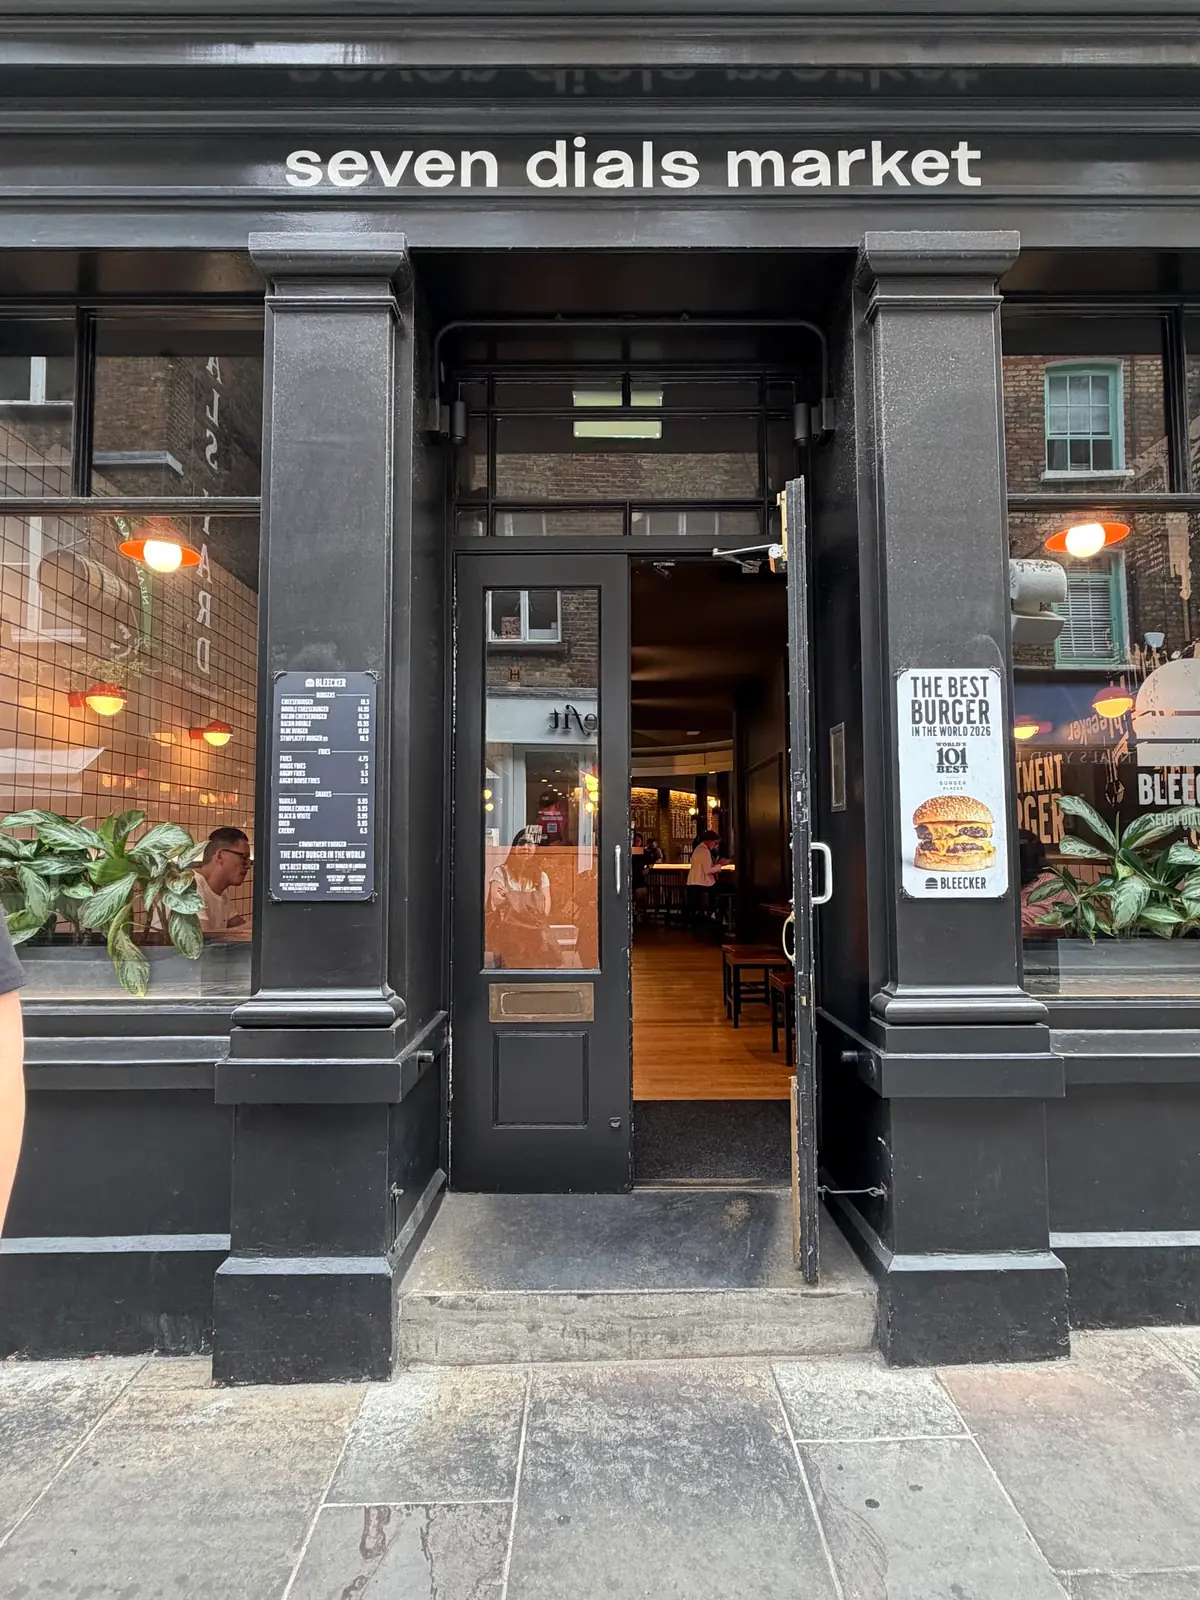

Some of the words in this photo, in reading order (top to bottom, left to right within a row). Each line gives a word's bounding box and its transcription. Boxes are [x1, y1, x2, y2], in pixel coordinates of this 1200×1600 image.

[284, 148, 498, 189] seven
[526, 136, 700, 189] dials
[727, 140, 983, 189] market
[316, 678, 346, 688] BLEECKER
[910, 676, 943, 698] THE
[948, 676, 990, 697] BEST
[911, 699, 990, 725] BURGER
[912, 726, 921, 737] IN
[922, 726, 938, 737] THE
[939, 726, 968, 737] WORLD
[970, 726, 991, 737] 2026
[936, 748, 968, 766] 101
[936, 766, 968, 774] BEST
[1138, 773, 1200, 806] BLEE
[1149, 813, 1180, 826] SEVEN
[280, 850, 291, 859] THE
[292, 850, 305, 859] BEST
[306, 850, 326, 859] BURGER
[327, 850, 334, 859] IN
[335, 850, 345, 859] THE
[346, 850, 365, 859] WORLD
[940, 876, 987, 890] BLEECKER
